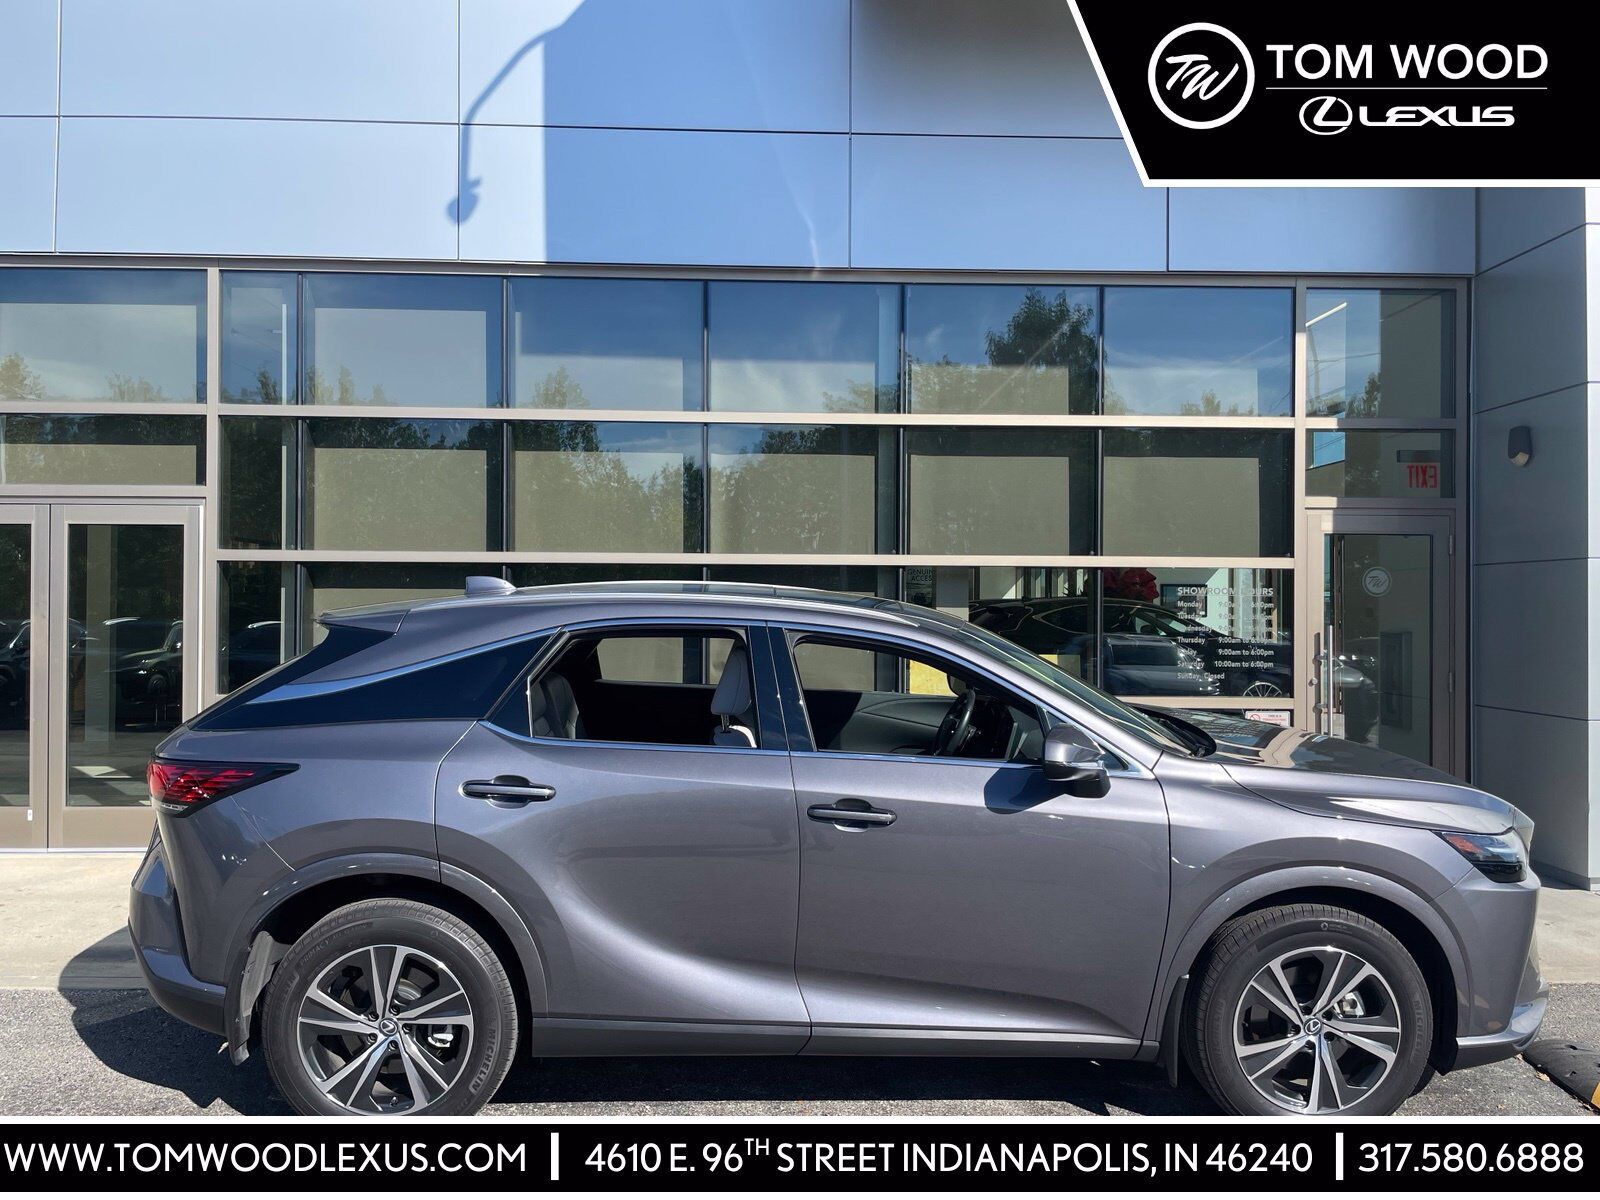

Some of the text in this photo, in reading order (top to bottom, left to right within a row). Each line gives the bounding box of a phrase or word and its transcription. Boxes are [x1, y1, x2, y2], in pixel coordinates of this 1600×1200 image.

[1177, 601, 1203, 609] Monday
[1177, 637, 1206, 645] Thursday
[1250, 649, 1275, 657] 6:00pm
[1177, 661, 1205, 669] Saturday
[1250, 661, 1274, 669] 6:00pm
[1203, 672, 1225, 680] Closed
[472, 1028, 497, 1091] MICHELIN
